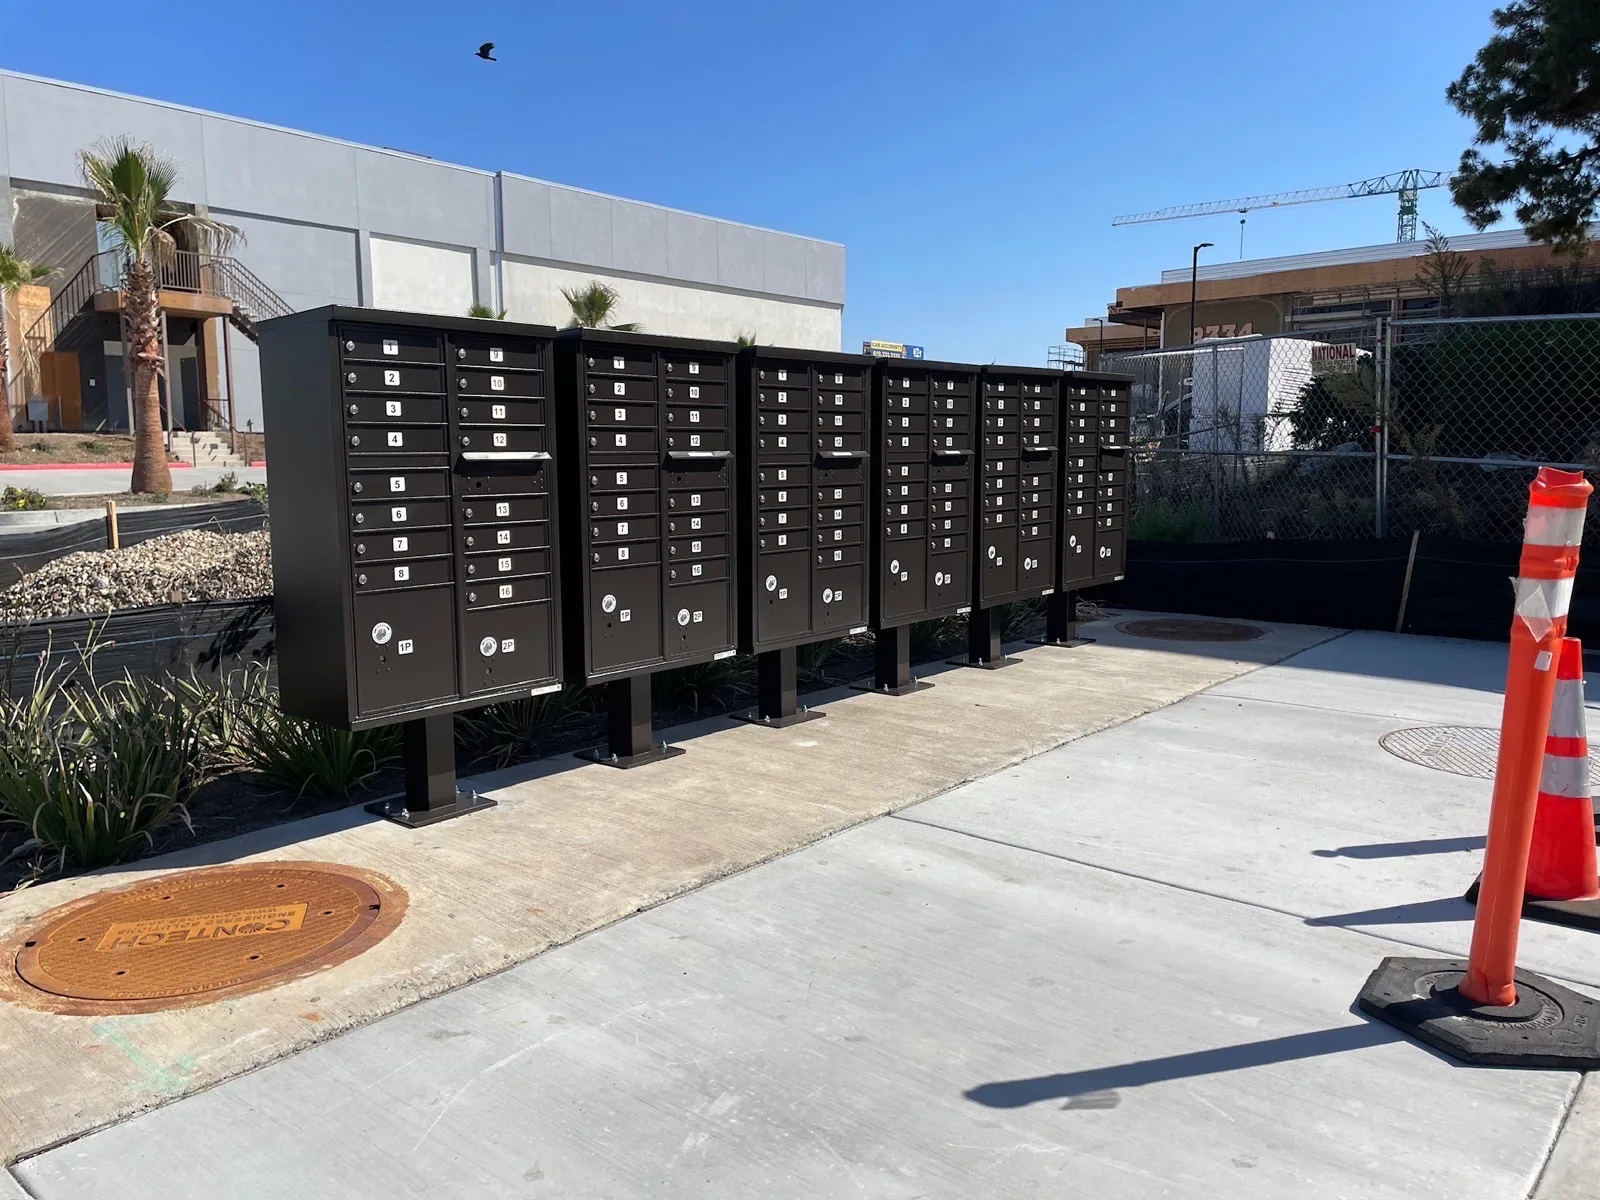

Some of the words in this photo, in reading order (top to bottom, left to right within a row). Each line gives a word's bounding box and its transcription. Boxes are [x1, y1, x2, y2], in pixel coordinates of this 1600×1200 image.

[388, 343, 393, 351] 1
[493, 350, 499, 359] 9
[1312, 344, 1356, 361] NATIONAL
[617, 359, 621, 367] 1
[389, 373, 395, 383] 2
[493, 379, 502, 388] 10
[617, 384, 622, 393] 2
[691, 388, 698, 396] 10
[390, 404, 397, 414] 3
[494, 408, 503, 416] 11
[618, 410, 623, 419] 3
[392, 435, 398, 444] 4
[495, 435, 505, 444] 12
[618, 436, 623, 444] 4
[691, 436, 699, 445] 12
[619, 474, 624, 483] 5
[394, 480, 401, 489] 5
[619, 499, 625, 508] 6
[692, 496, 700, 504] 13
[498, 505, 508, 514] 13
[396, 510, 402, 519] 6
[620, 524, 625, 533] 7
[499, 533, 508, 541] 14
[397, 540, 403, 549] 7
[621, 549, 626, 558] 8
[501, 560, 510, 568] 15
[398, 569, 404, 578] 8
[693, 566, 701, 574] 16
[501, 587, 511, 596] 16
[621, 611, 630, 619] 1P
[694, 612, 702, 621] 2P
[400, 642, 411, 652] 1P
[503, 641, 513, 650] 2P
[110, 918, 291, 949] CONTECH
